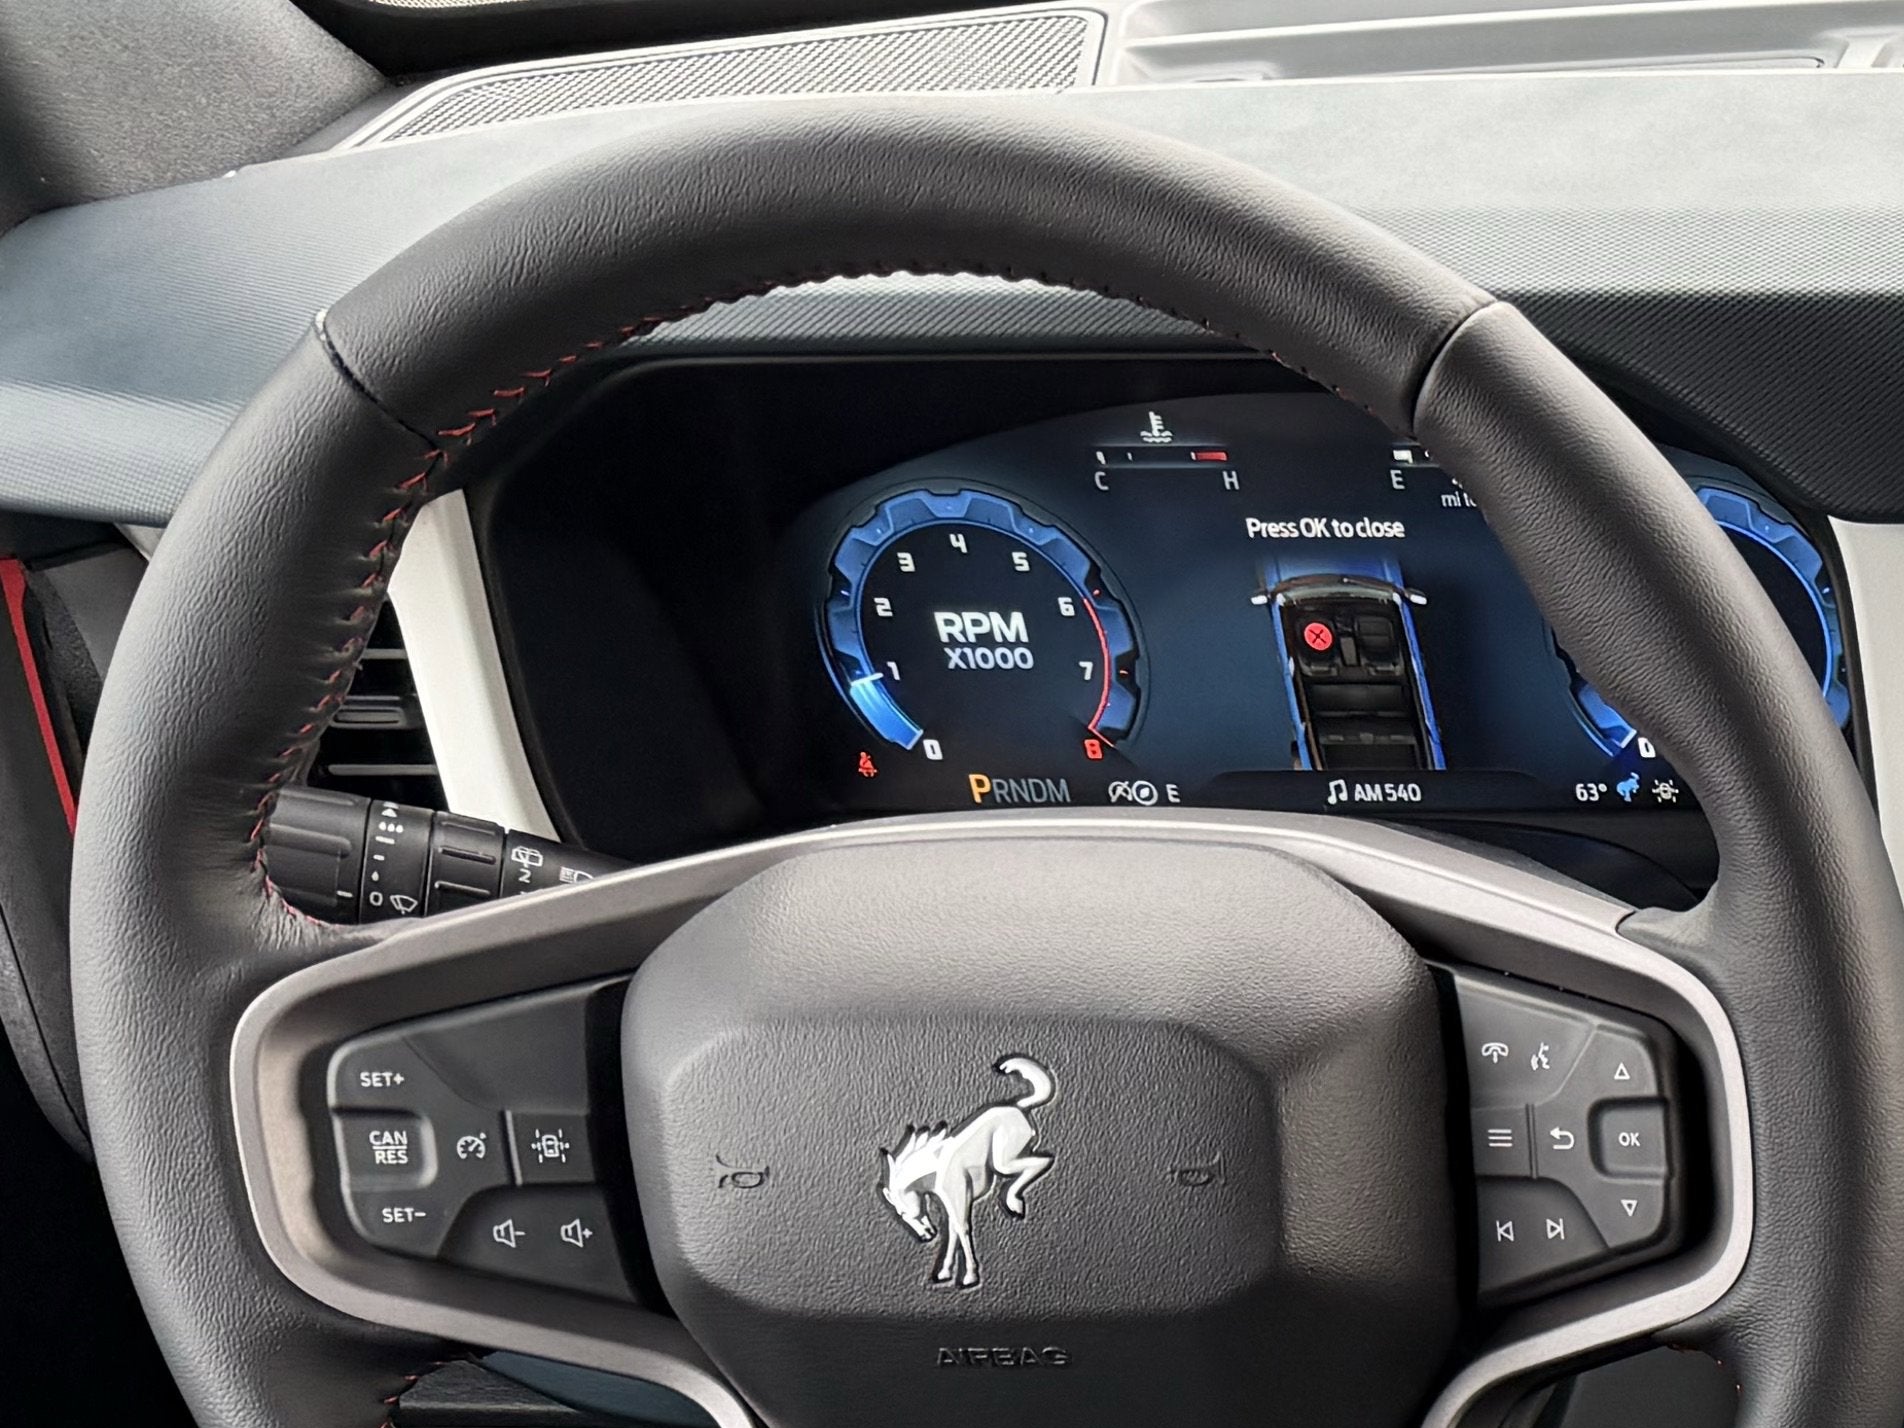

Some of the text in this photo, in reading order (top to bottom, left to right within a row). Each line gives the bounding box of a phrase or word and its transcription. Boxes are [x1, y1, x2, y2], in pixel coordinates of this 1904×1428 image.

[1094, 471, 1109, 490] C
[1223, 471, 1241, 490] H
[1390, 469, 1405, 489] E
[1246, 517, 1405, 538] Press OK to close
[949, 533, 968, 553] 4
[897, 552, 916, 572] 3
[1012, 551, 1030, 572] 5
[874, 597, 893, 617] 2
[1057, 596, 1075, 616] 6
[934, 611, 1030, 642] RPM
[944, 647, 1034, 670] X1000
[887, 661, 901, 680] 1
[1079, 661, 1094, 680] 7
[923, 739, 943, 760] 0
[1084, 739, 1103, 759] 8
[1166, 784, 1181, 803] E
[1354, 782, 1422, 802] AM 540
[1575, 782, 1608, 802] 63°
[518, 868, 532, 883] 2
[360, 1071, 406, 1088] SET+
[369, 1130, 408, 1146] CAN
[1618, 1132, 1641, 1147] OK
[375, 1150, 409, 1165] RES
